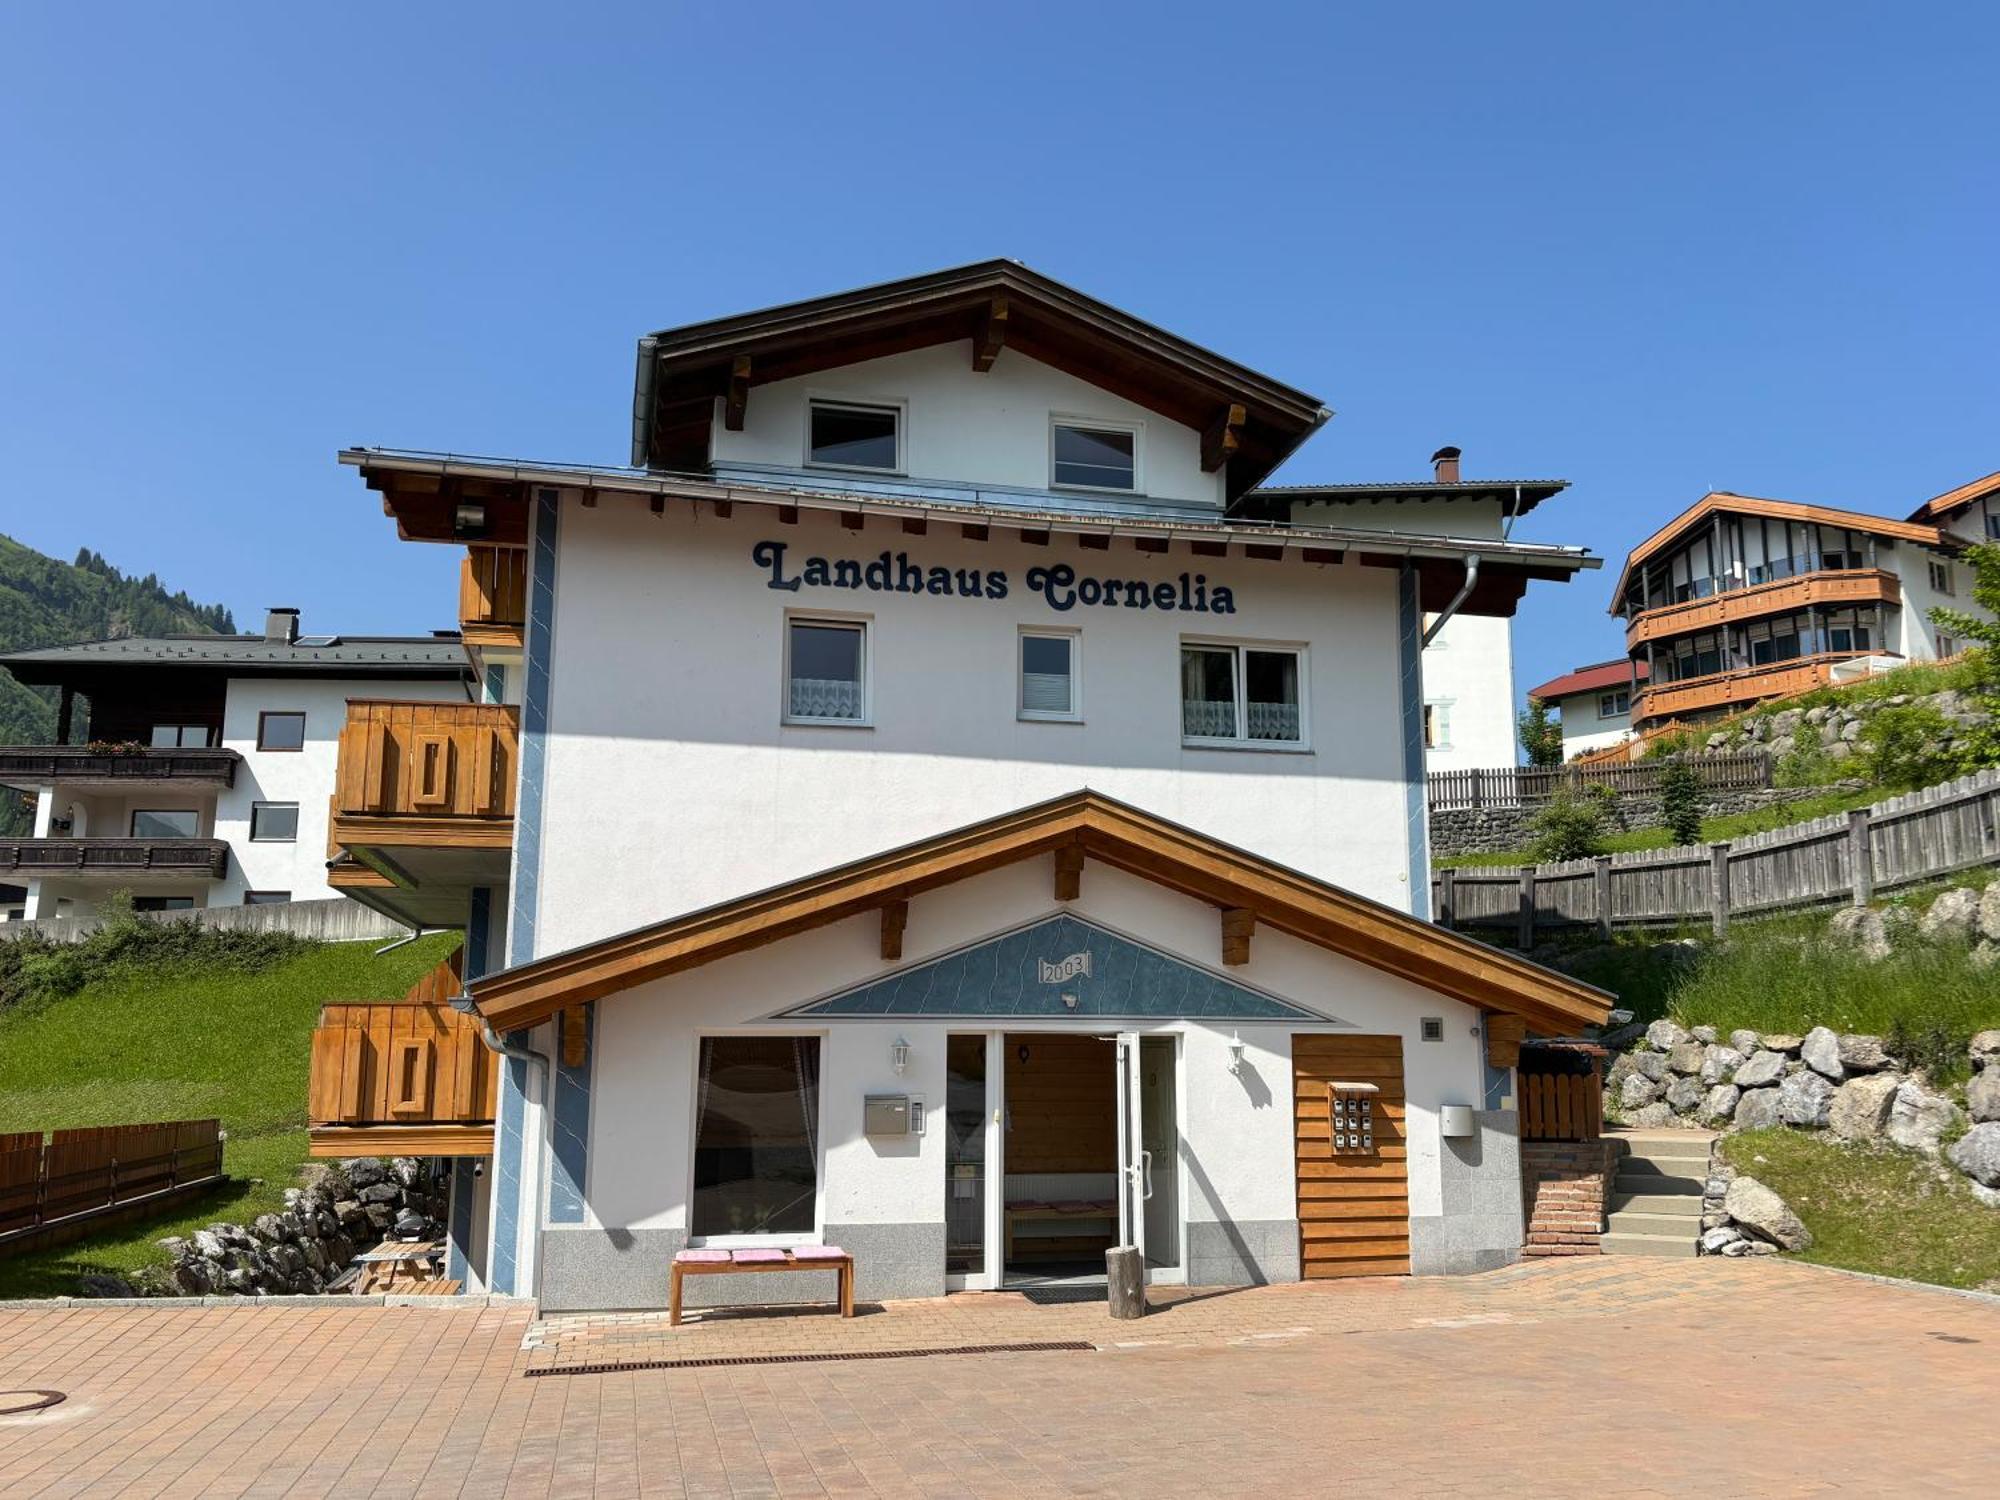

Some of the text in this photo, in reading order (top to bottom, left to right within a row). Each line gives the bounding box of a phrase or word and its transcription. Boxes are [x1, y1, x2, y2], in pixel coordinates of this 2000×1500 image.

[752, 541, 1236, 614] Landhaus Cornelia
[1045, 957, 1083, 982] 2003
